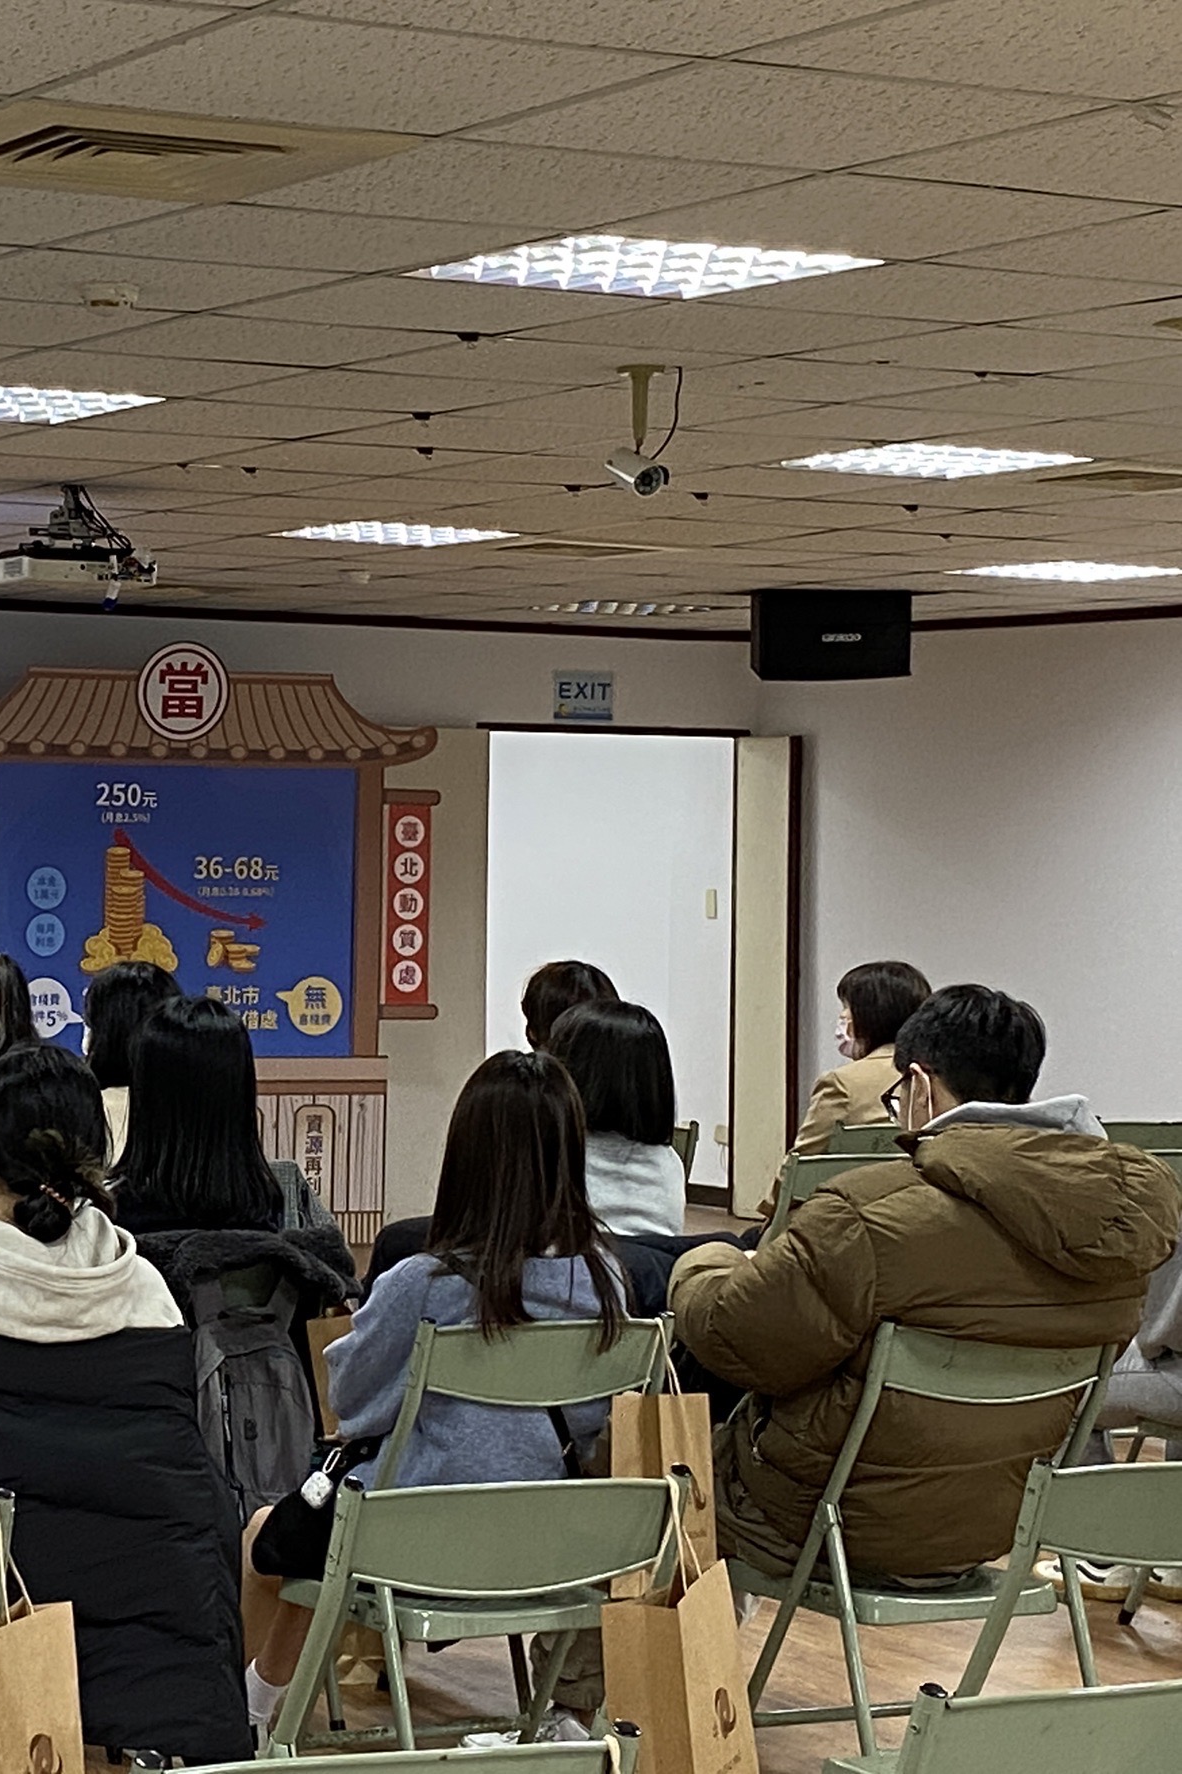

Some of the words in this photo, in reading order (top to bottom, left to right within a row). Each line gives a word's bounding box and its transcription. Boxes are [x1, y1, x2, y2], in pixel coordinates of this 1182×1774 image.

[159, 661, 209, 720] 當
[558, 681, 611, 701] EXIT
[95, 782, 158, 808] 250元
[194, 856, 280, 881] 36-68元
[303, 984, 328, 1011] 無
